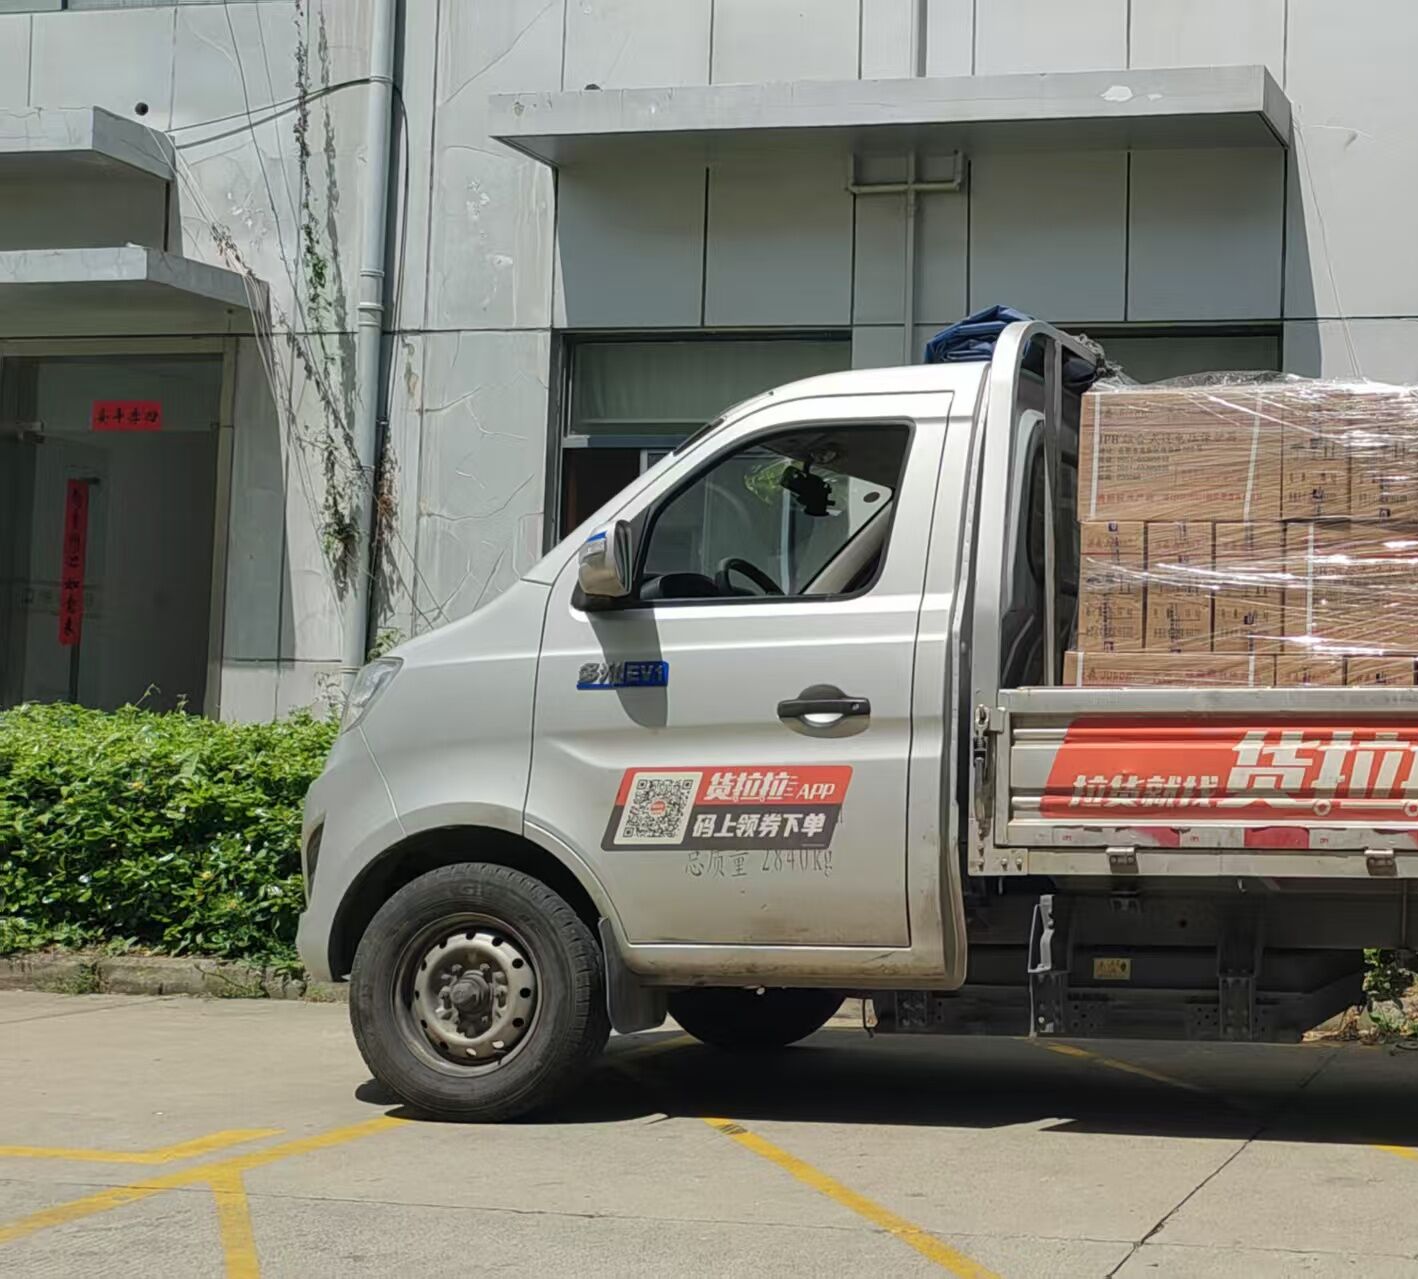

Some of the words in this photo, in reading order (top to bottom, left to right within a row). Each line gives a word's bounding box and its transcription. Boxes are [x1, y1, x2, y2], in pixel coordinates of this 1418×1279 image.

[703, 771, 790, 803] 货拉拉
[796, 783, 836, 800] APP
[1069, 774, 1219, 808] 拉货就找
[692, 813, 826, 837] 码上领券下单
[685, 850, 750, 878] 总质量
